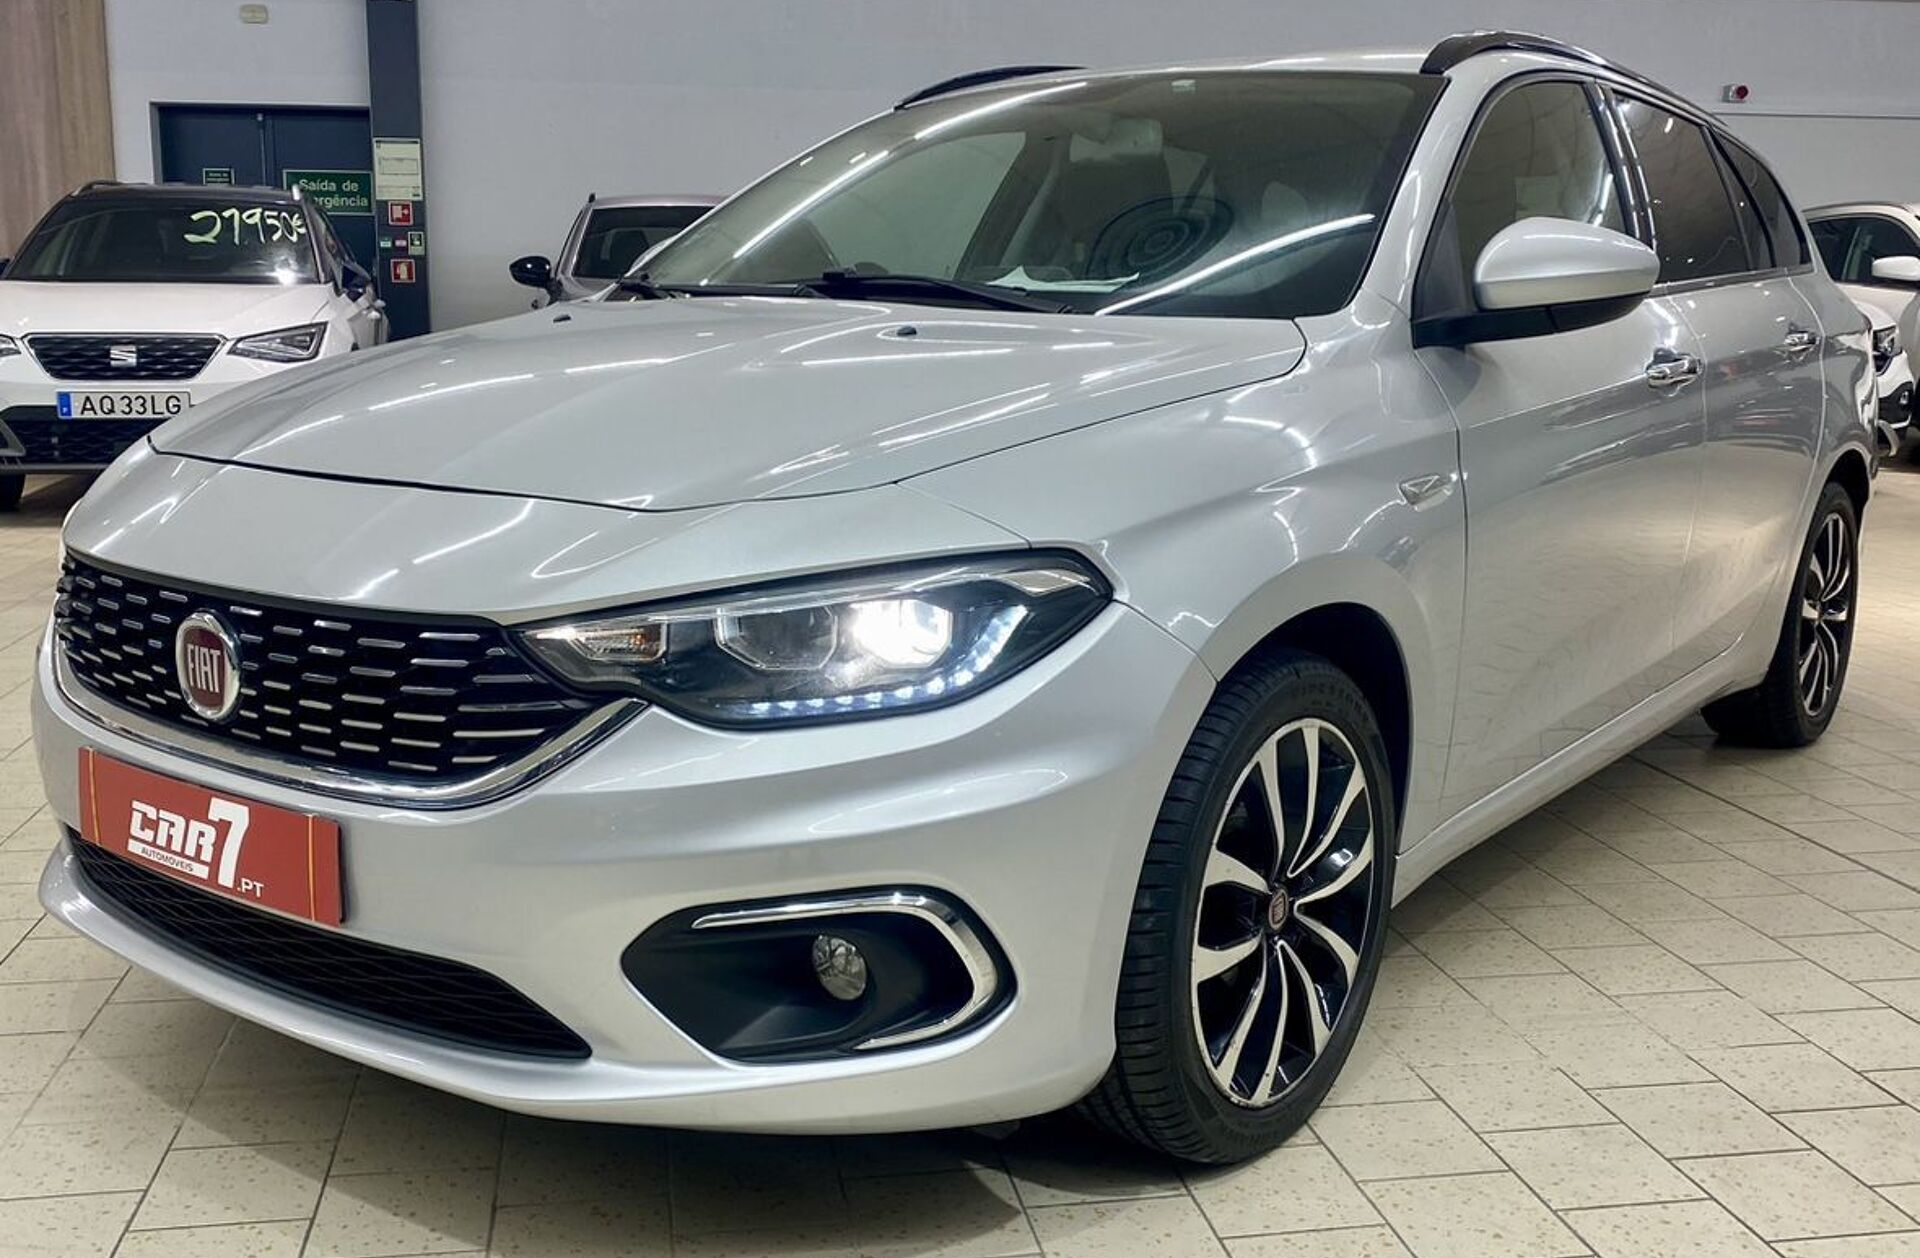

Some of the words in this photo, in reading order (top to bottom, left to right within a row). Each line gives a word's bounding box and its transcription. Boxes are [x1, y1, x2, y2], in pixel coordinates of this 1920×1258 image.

[299, 179, 337, 192] Saída
[342, 180, 359, 192] de
[313, 194, 369, 209] rgência
[186, 643, 221, 693] FIAT
